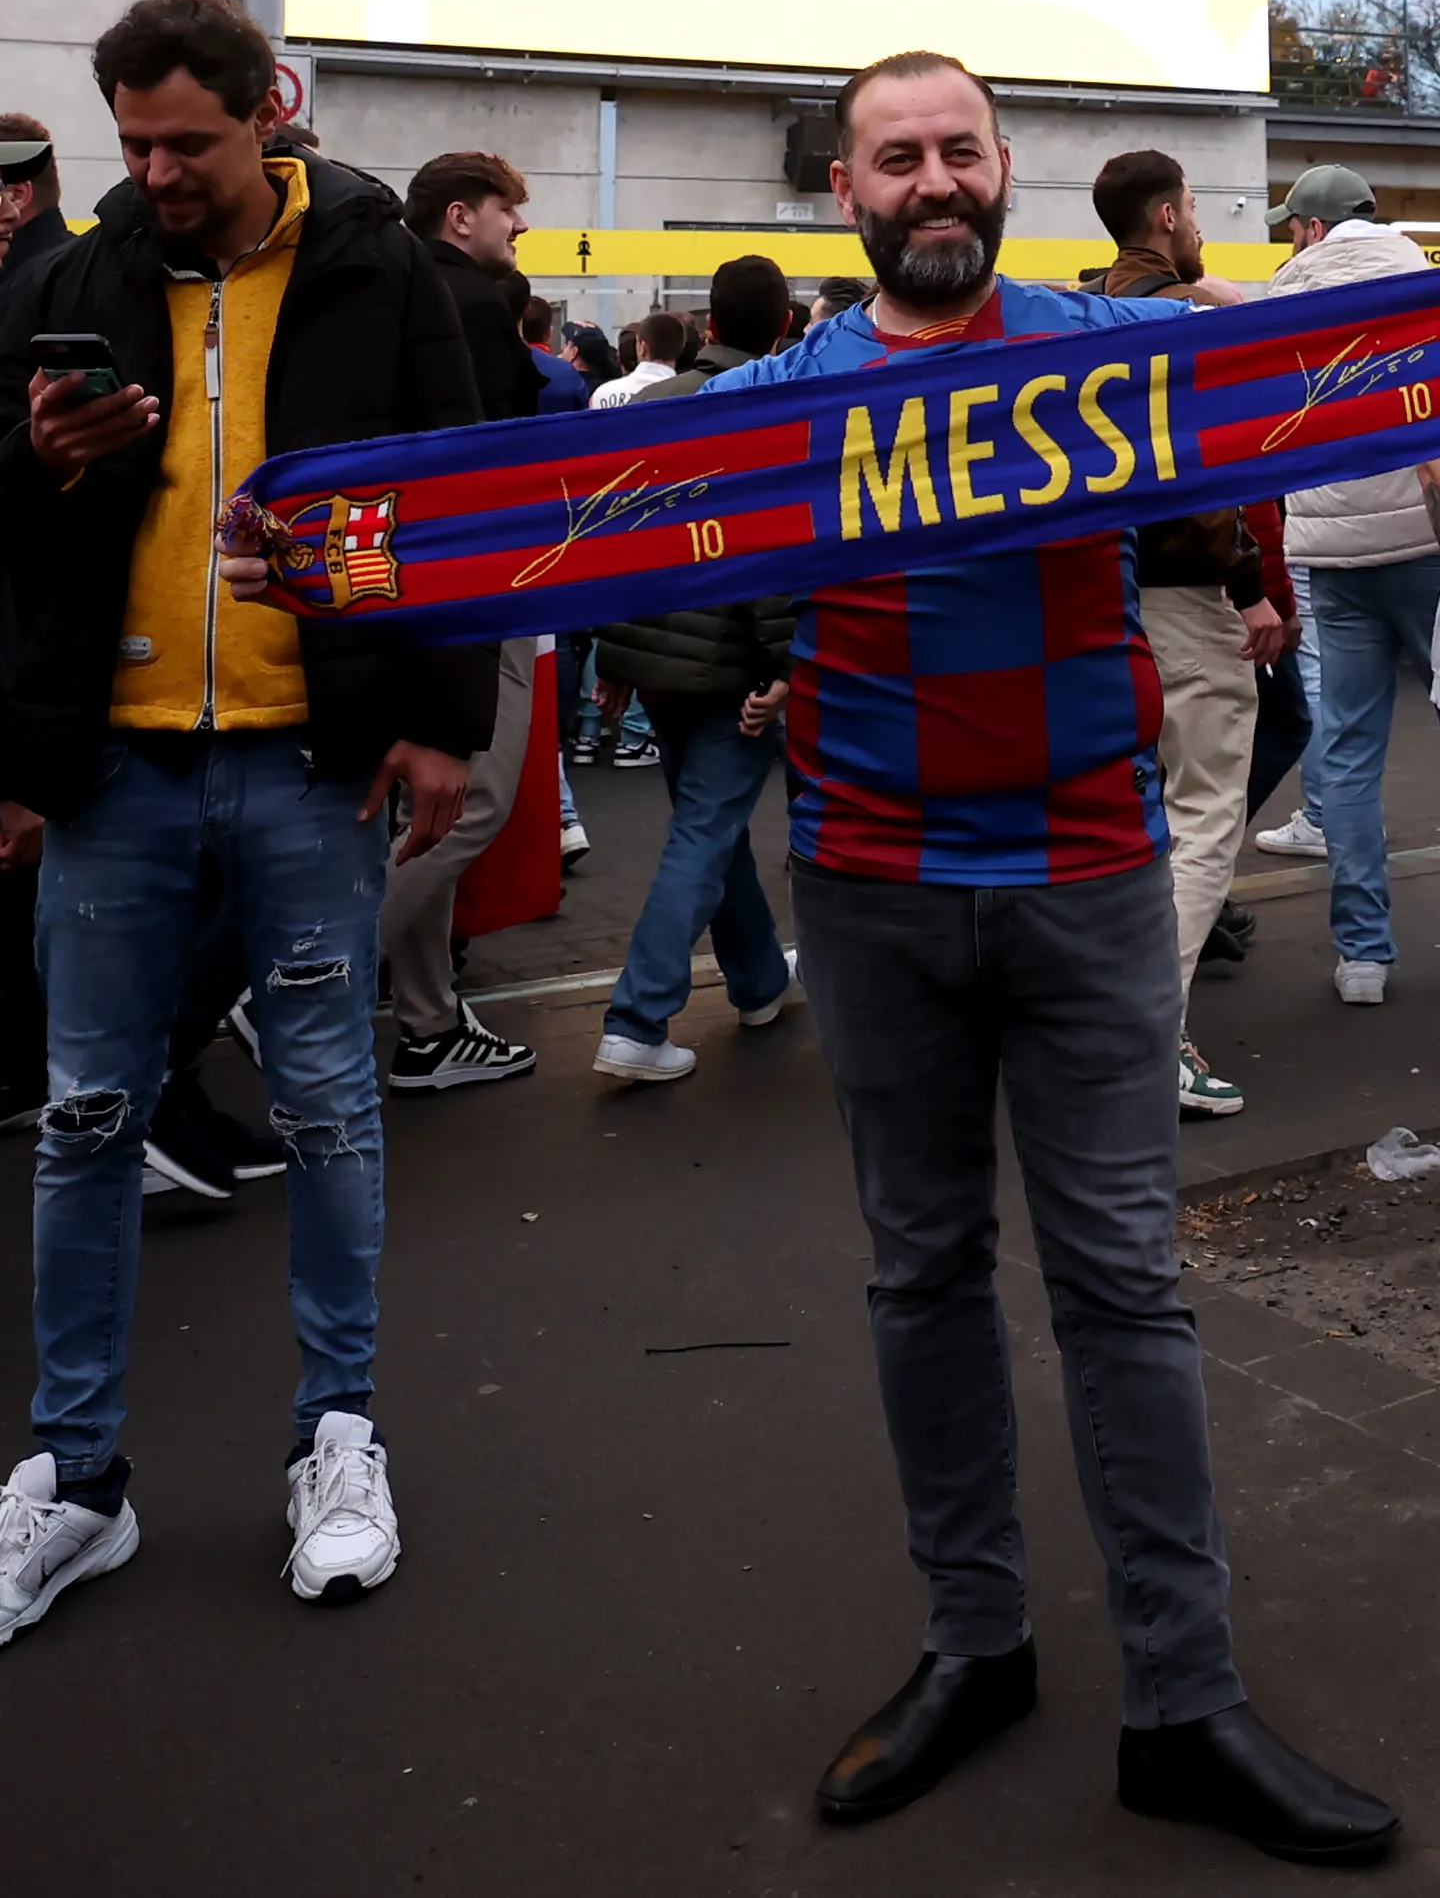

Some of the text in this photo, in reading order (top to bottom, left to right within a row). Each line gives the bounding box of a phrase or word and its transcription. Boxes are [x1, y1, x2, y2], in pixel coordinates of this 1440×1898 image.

[1398, 382, 1432, 423] 10
[839, 354, 1177, 541] MESSI
[686, 518, 726, 563] 10
